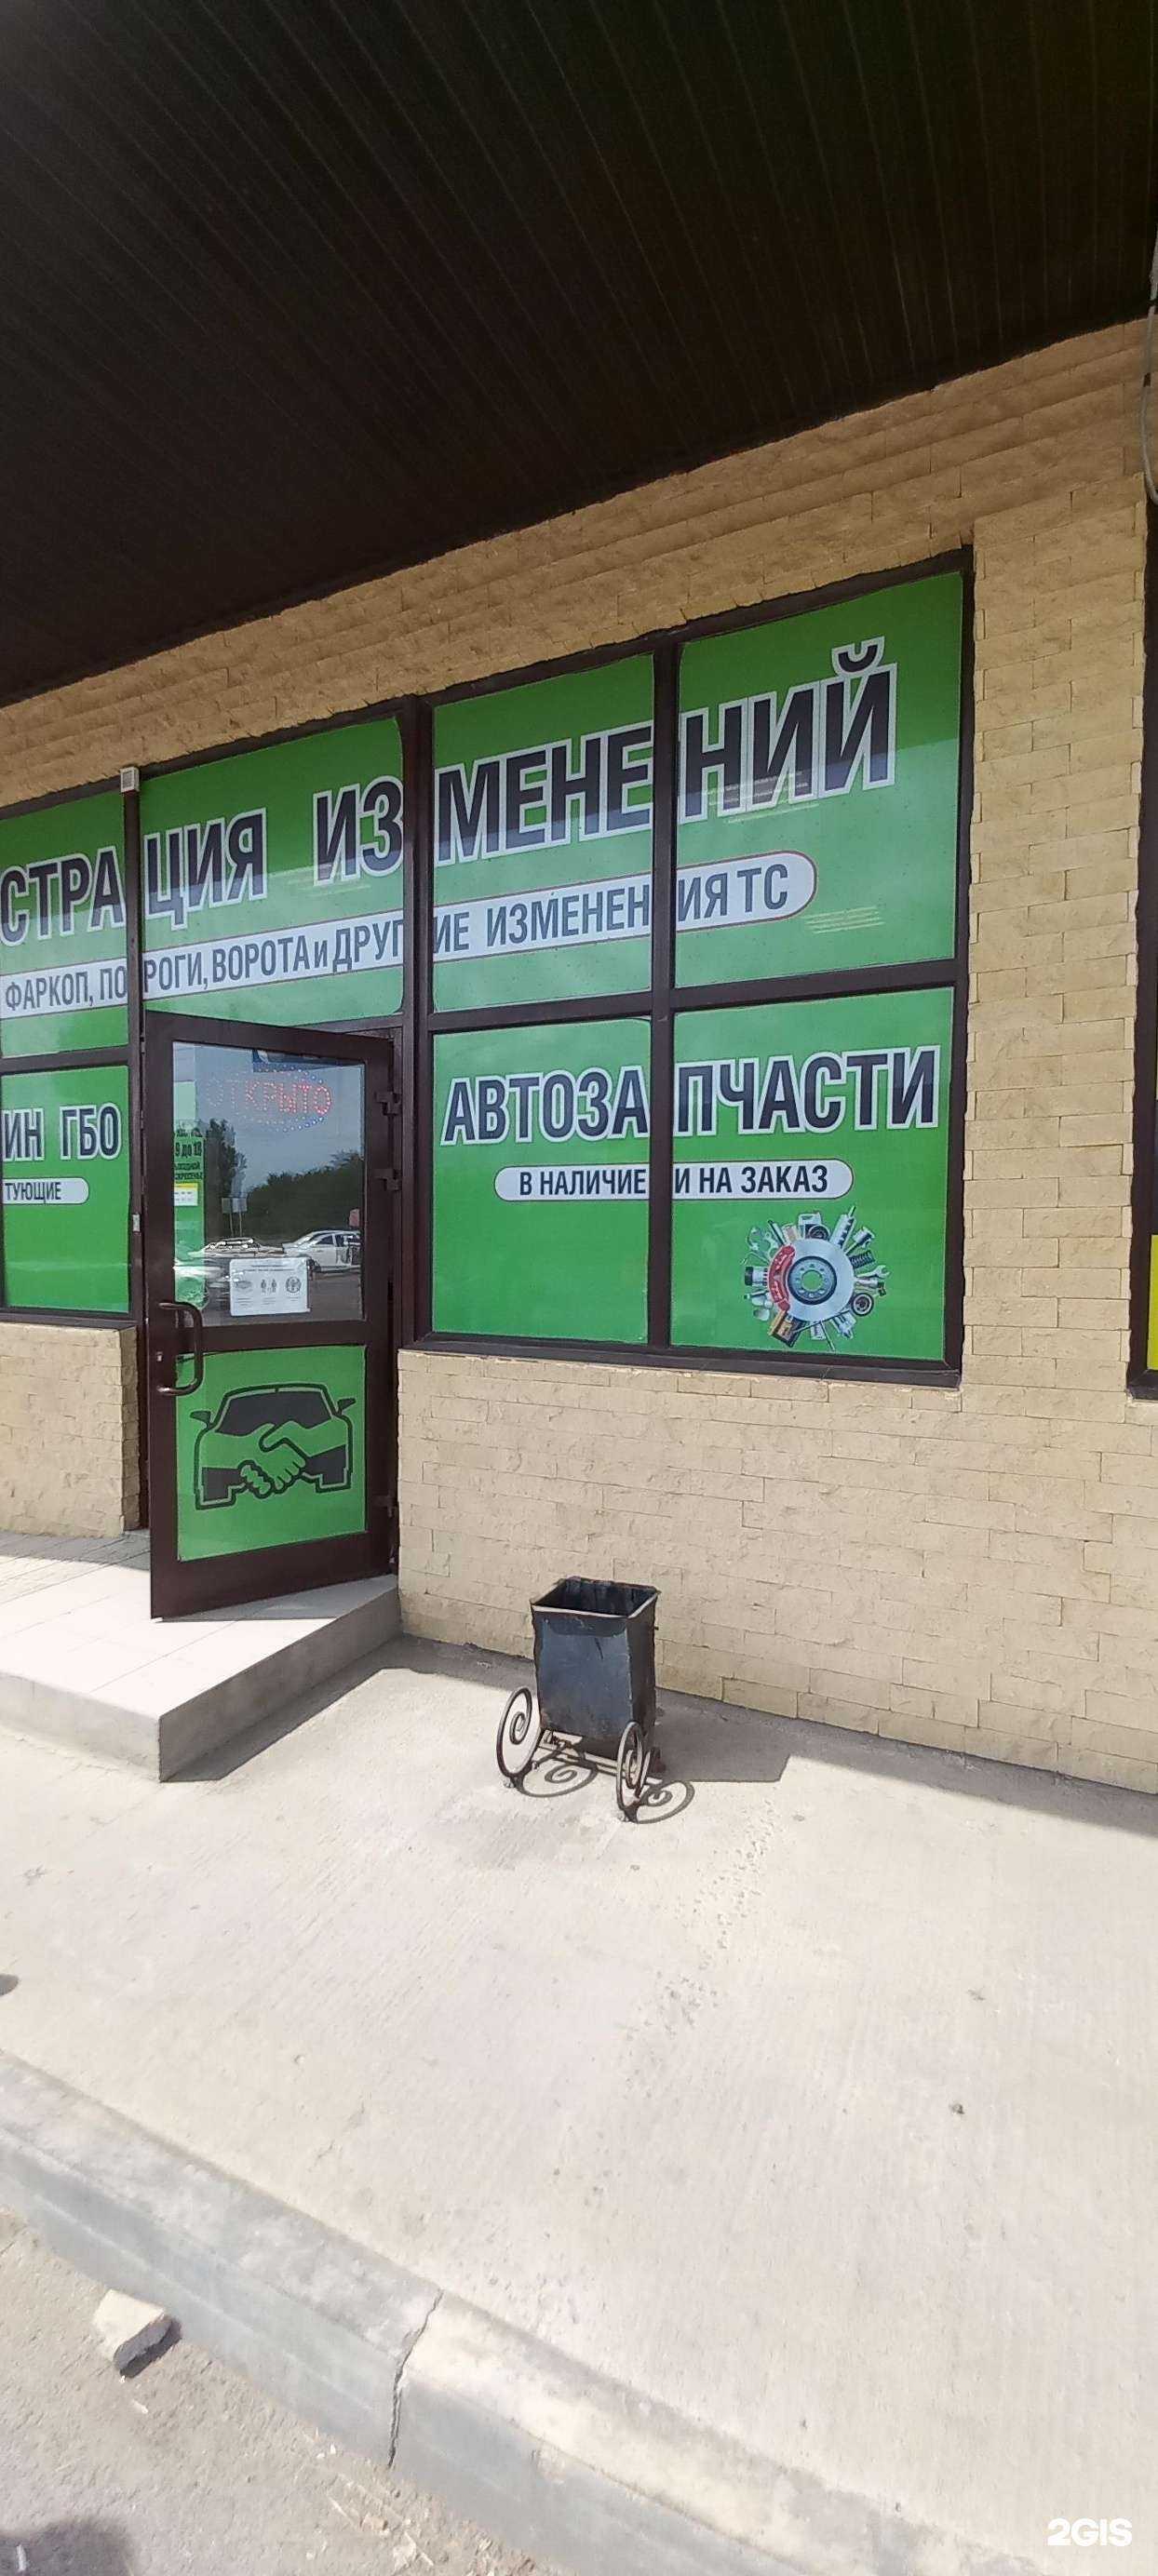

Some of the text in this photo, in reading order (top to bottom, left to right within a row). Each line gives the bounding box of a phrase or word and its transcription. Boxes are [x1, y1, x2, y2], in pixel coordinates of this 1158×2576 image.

[313, 637, 896, 886] ИЗМЕНЕНИЙ
[6, 971, 94, 1011] ФАРКОП,
[100, 951, 209, 1000] ПОРОГИ,
[212, 935, 310, 983] ВОРОТА
[332, 913, 469, 973] ДРУГИЕ
[486, 872, 728, 947] ИЗМЕНЕНИЯ
[736, 864, 788, 913] ТС
[207, 1079, 332, 1116] ОТКРЫТО
[440, 1045, 941, 1146] АВТОЗАПЧАСТИ
[60, 1102, 121, 1161] ГБО
[5, 1181, 61, 1204] ТУЮЩИЕ
[519, 1165, 828, 1196] В НАЛИЧИЕ И НА ЗАКАЗ
